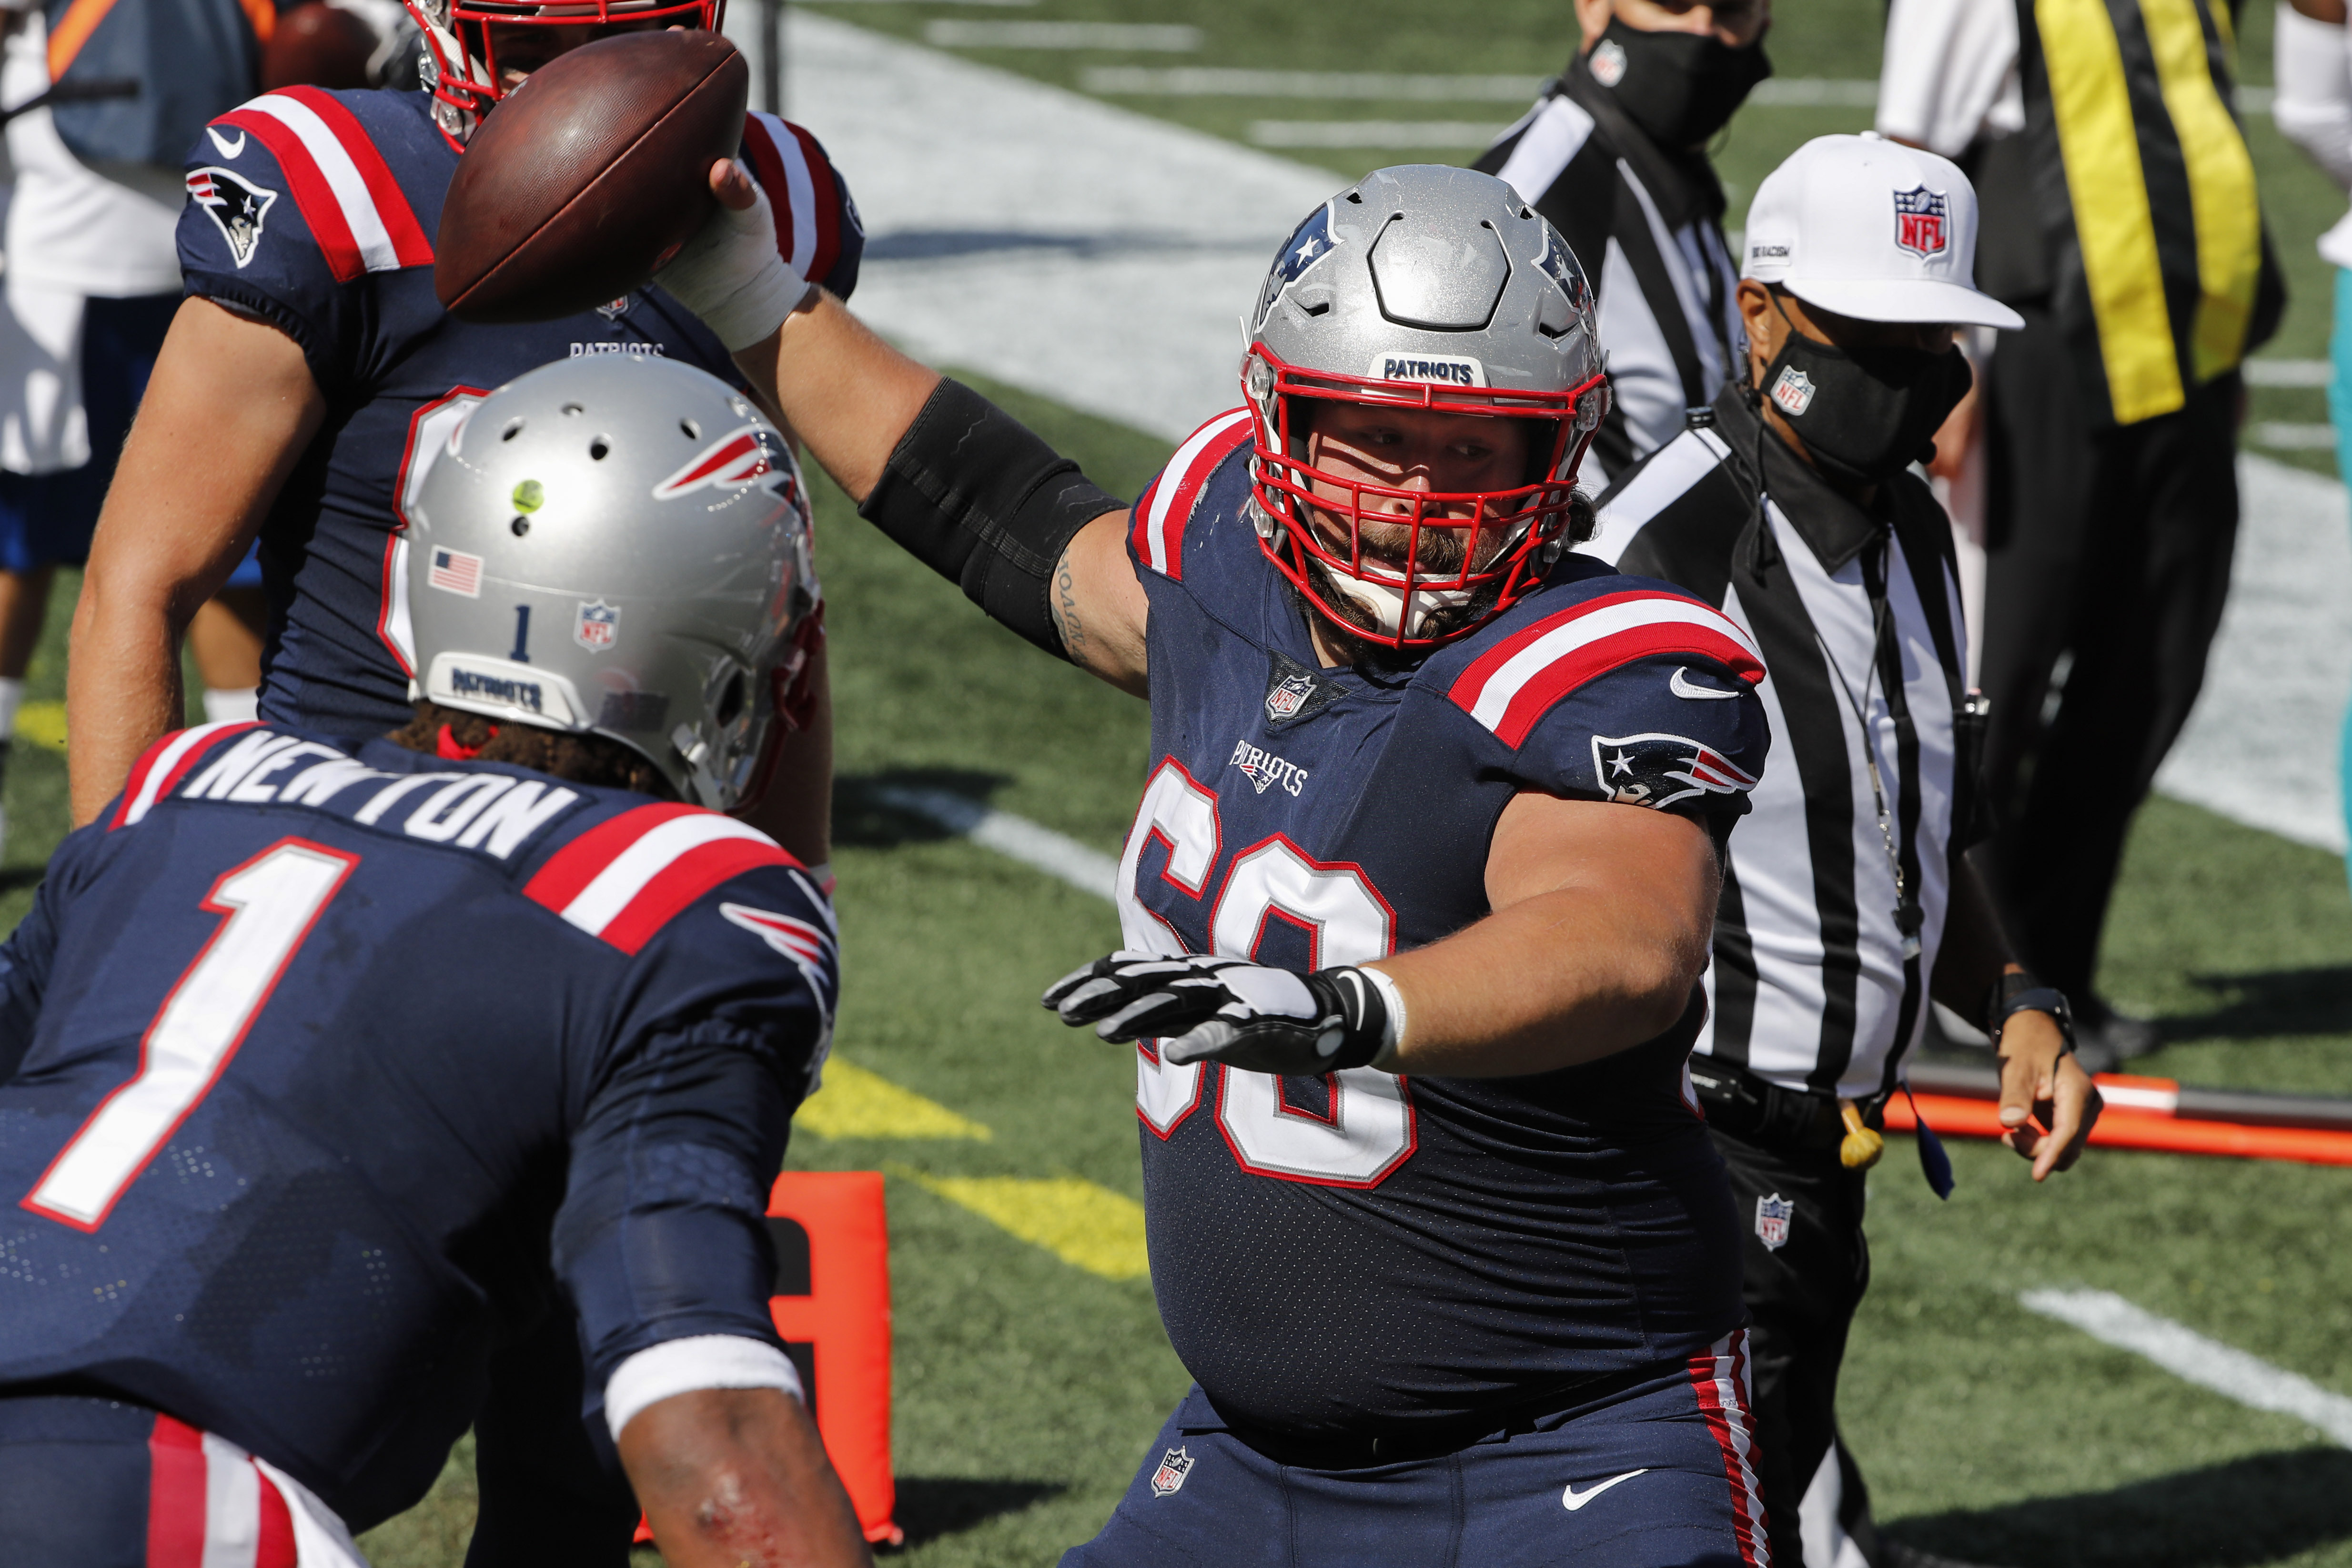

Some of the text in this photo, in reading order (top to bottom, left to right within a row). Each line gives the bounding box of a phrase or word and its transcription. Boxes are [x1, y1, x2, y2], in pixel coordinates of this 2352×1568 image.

[1901, 213, 1946, 253] NFL
[569, 342, 665, 358] PATRIOTS
[1384, 358, 1472, 384] PATRIOTS
[1776, 382, 1803, 410] NFL
[509, 605, 531, 663] 1
[580, 620, 612, 644] NFL
[452, 667, 542, 713] PATRIOTS
[1272, 689, 1297, 711] NFL
[1228, 739, 1309, 797] PATRIOTS
[182, 729, 579, 860] NEWTON
[18, 834, 362, 1234] 1
[1761, 1218, 1785, 1241] NFL
[1155, 1467, 1178, 1488] NFL
